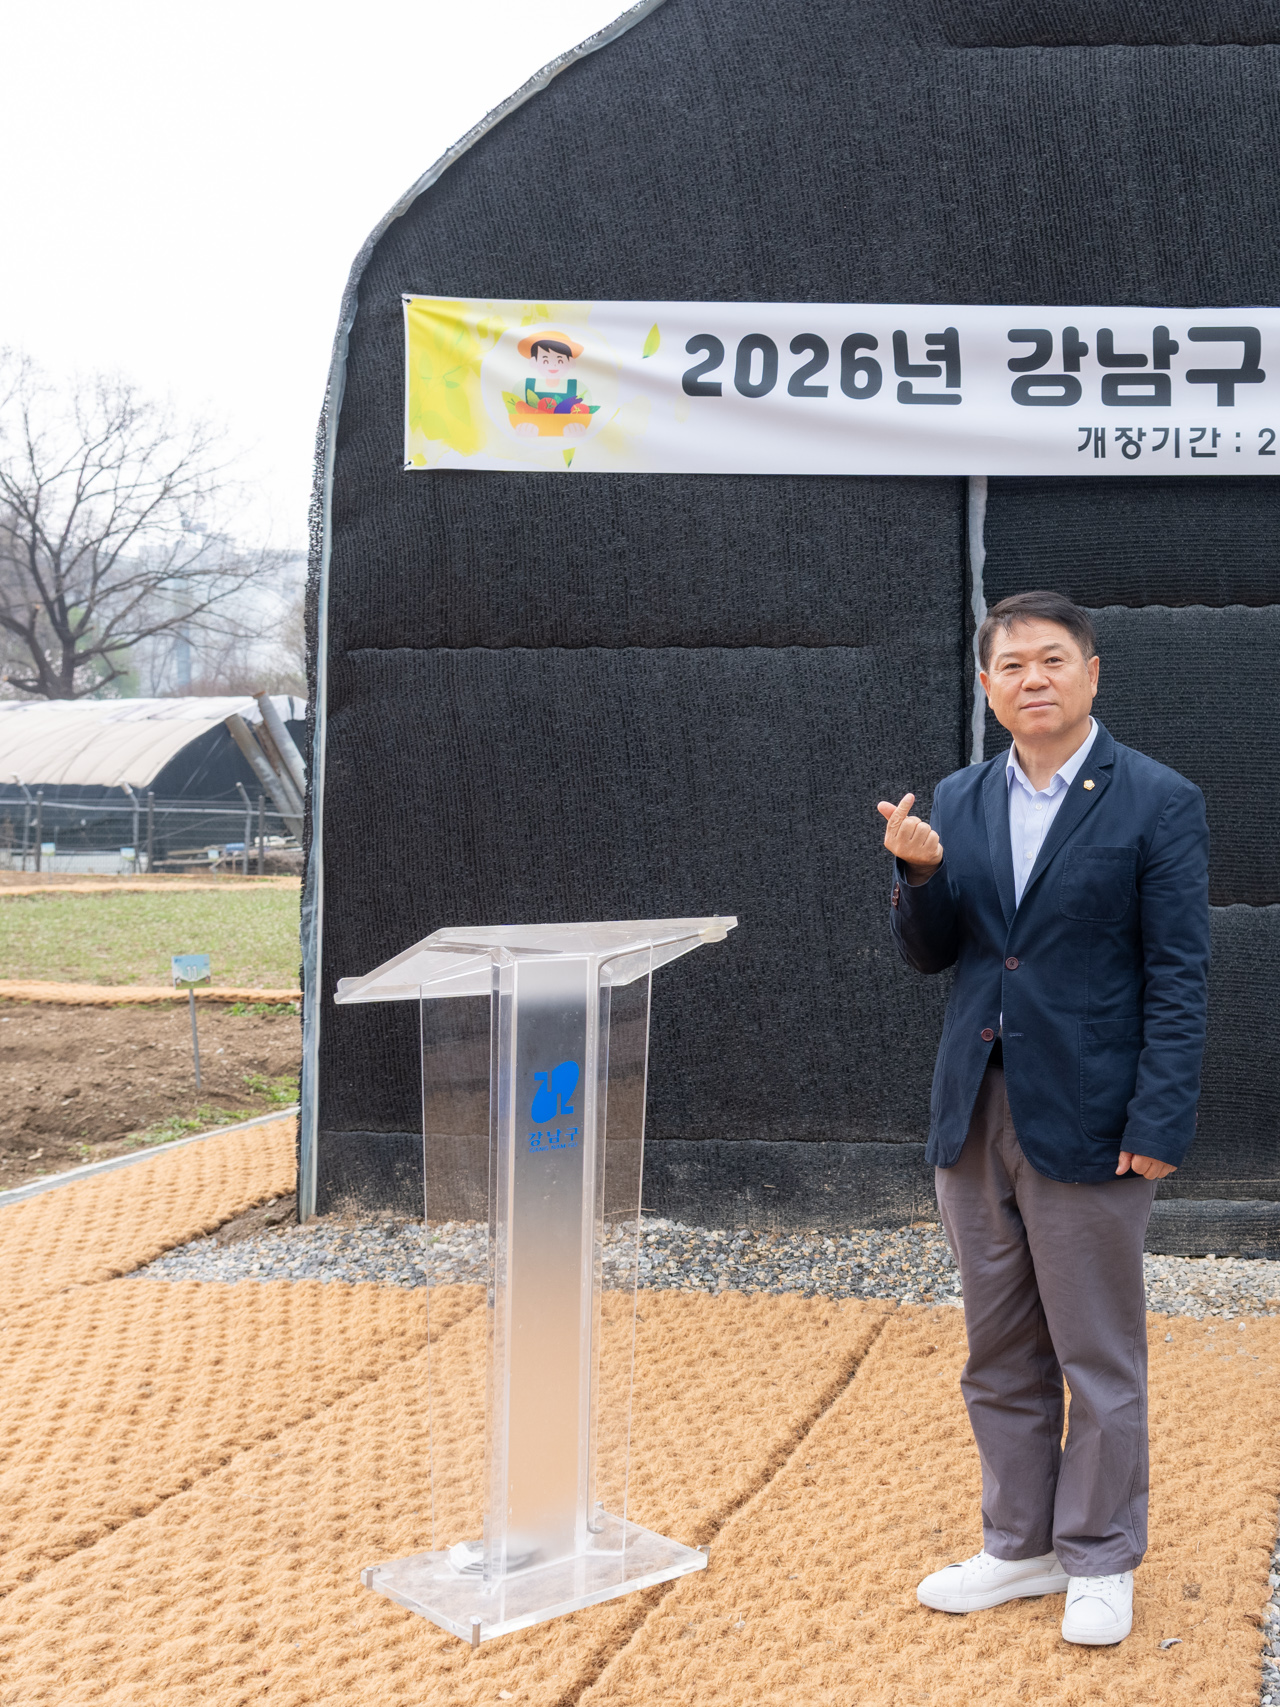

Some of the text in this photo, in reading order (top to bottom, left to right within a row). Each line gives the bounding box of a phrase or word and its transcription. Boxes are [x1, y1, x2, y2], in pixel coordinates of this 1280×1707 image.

[681, 326, 962, 405] 2026년
[1008, 325, 1267, 407] 강남구
[1077, 427, 1221, 459] 개장기간
[186, 966, 197, 980] 11
[527, 1127, 580, 1146] 강남구
